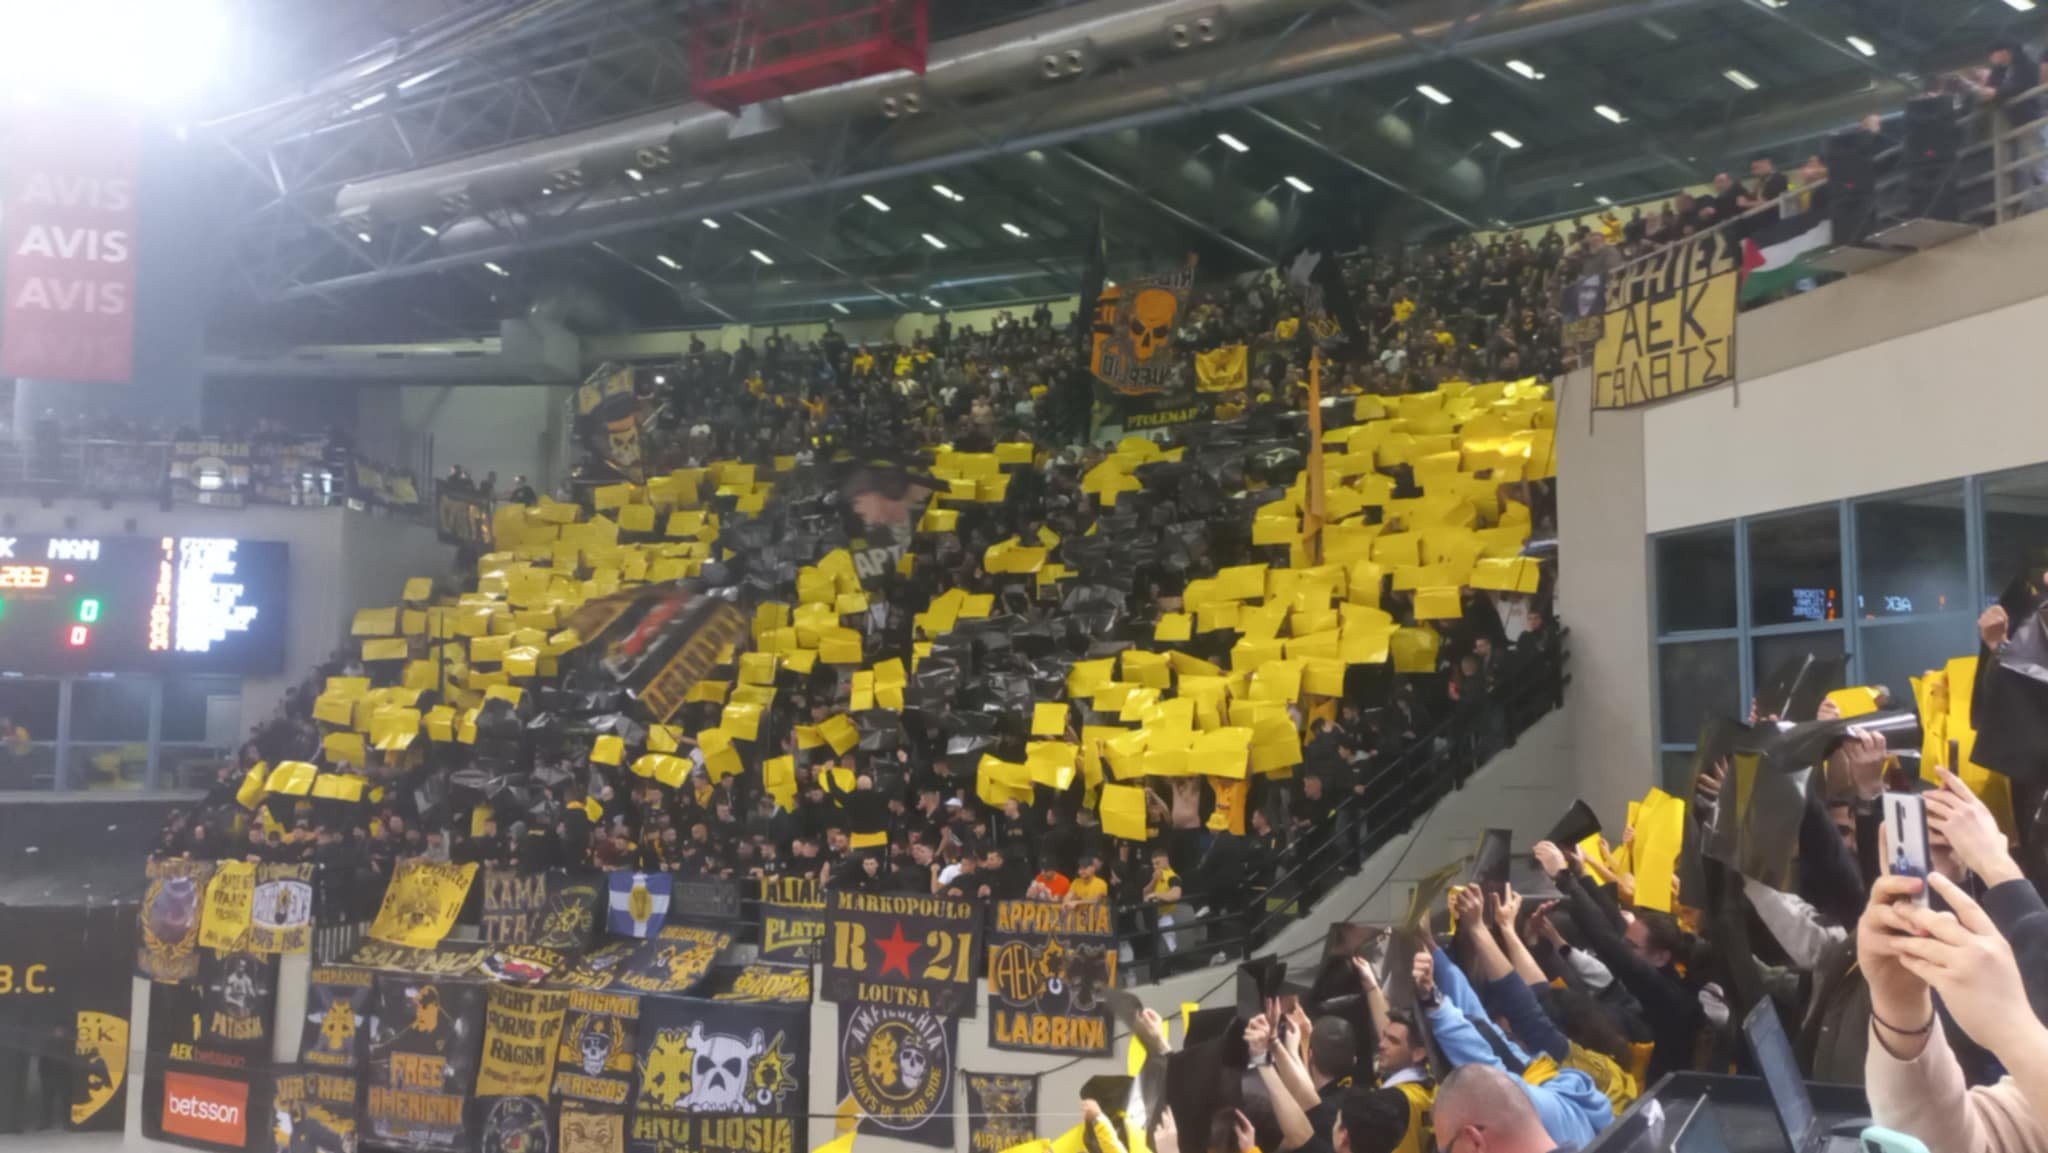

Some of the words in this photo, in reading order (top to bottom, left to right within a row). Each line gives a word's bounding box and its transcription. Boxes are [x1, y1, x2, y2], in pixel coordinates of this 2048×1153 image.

[23, 174, 130, 212] AVIS
[17, 225, 129, 263] AVIS
[15, 277, 126, 315] AVIS
[80, 599, 99, 622] 0
[70, 625, 88, 645] 0
[838, 891, 971, 919] MARKOPOULO
[832, 920, 867, 971] R
[922, 930, 973, 983] 21
[997, 943, 1038, 1001] AEK
[569, 989, 639, 1019] ORIGINAL
[857, 982, 931, 1008] LOUTSA
[169, 1042, 193, 1061] AEK
[391, 1051, 446, 1088] FREE
[168, 1092, 238, 1125] betsson
